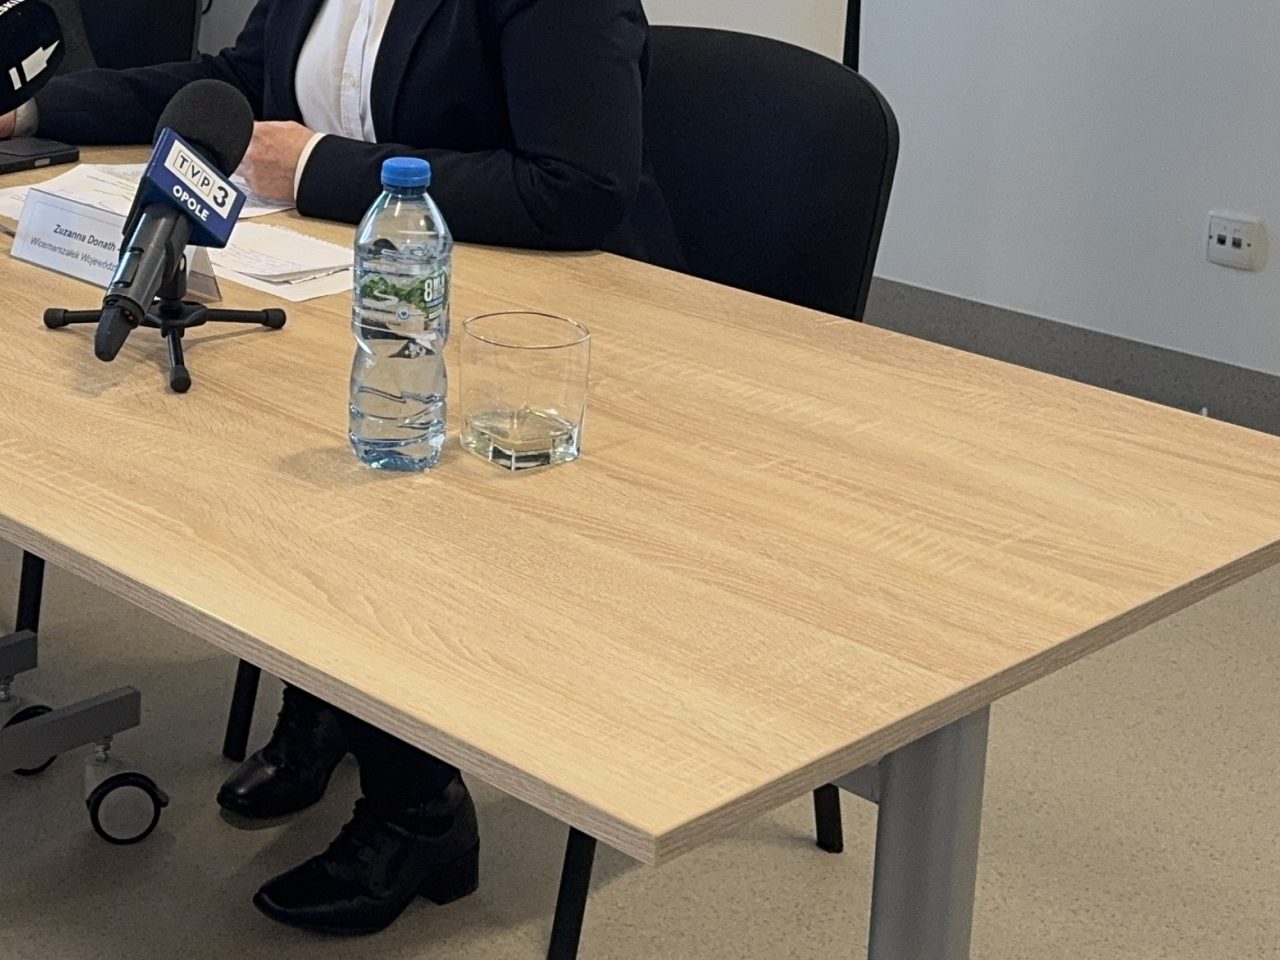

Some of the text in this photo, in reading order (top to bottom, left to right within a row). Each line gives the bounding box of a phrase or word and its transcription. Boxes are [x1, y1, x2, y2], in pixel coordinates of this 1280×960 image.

[172, 185, 210, 221] OPOLE
[53, 224, 116, 251] Zuzanna Donath
